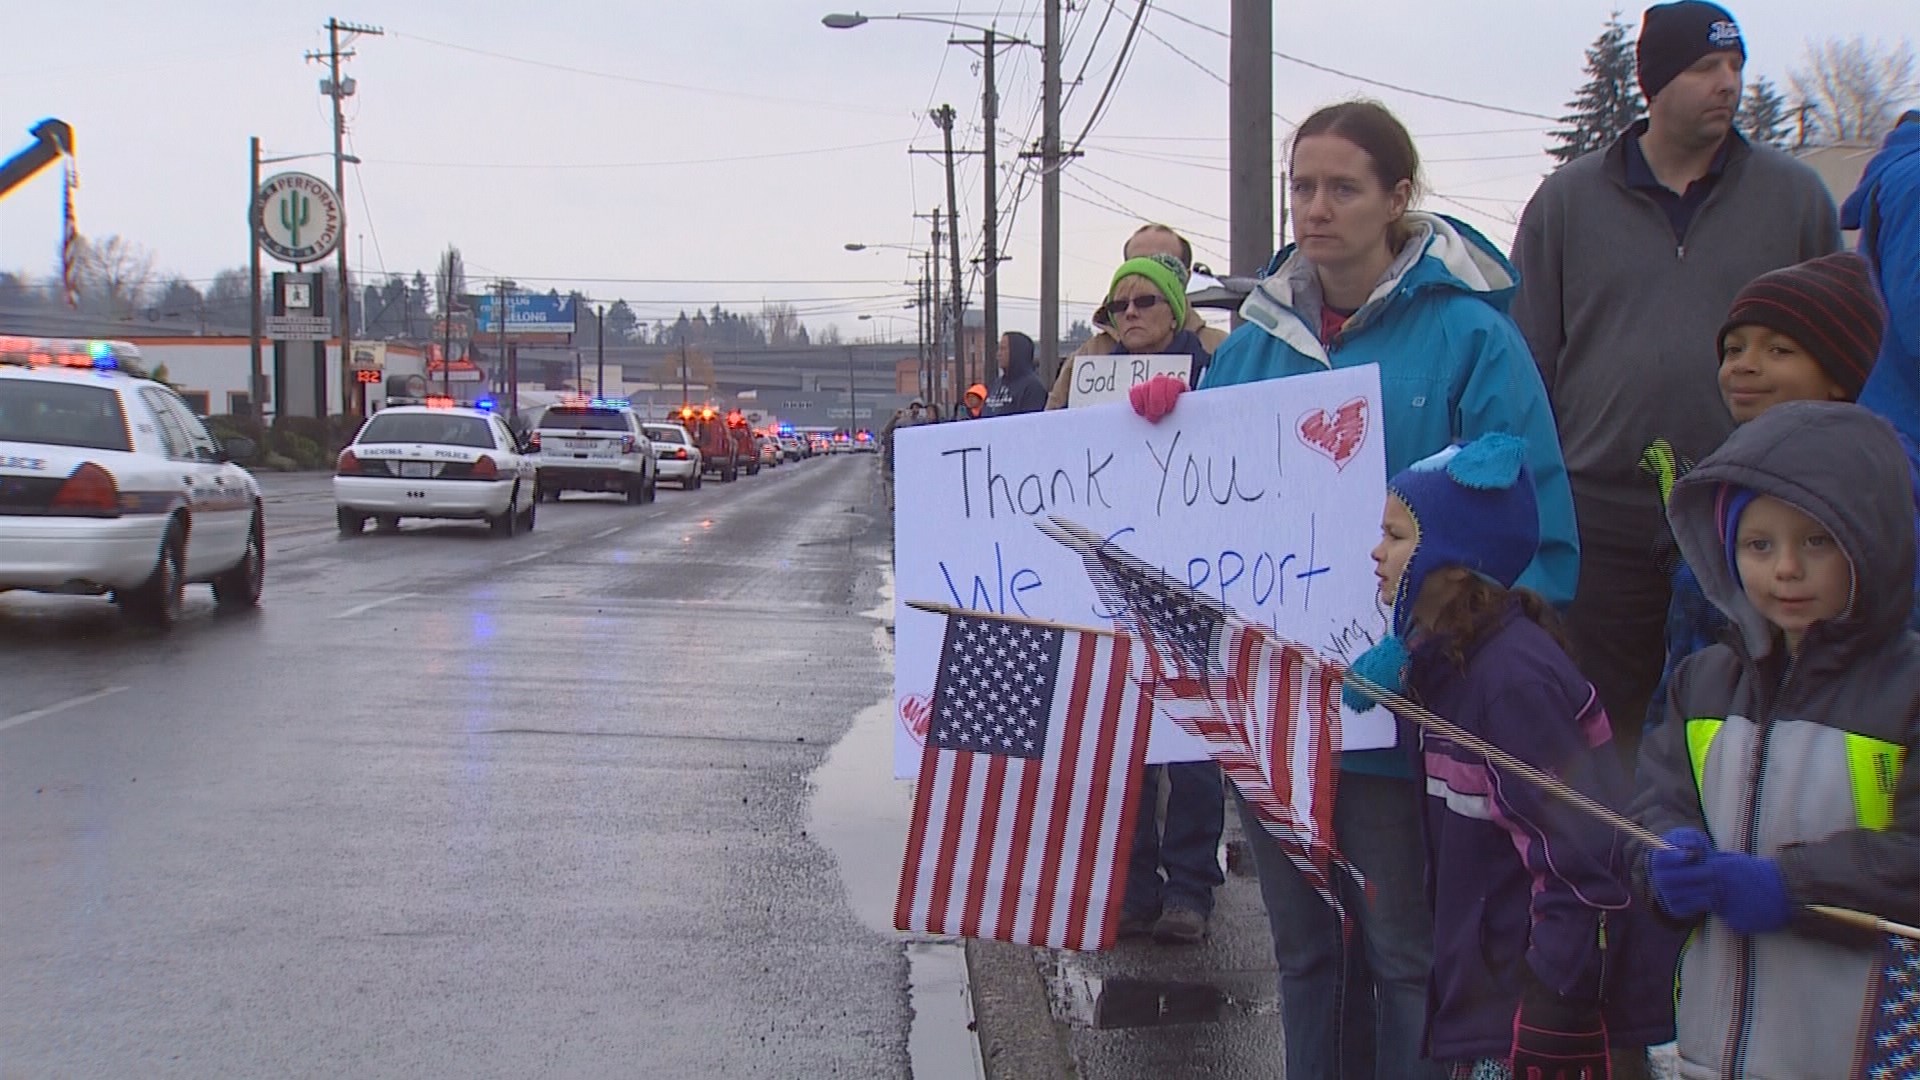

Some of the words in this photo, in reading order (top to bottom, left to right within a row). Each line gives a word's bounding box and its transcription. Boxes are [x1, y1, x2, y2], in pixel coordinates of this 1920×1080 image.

[277, 177, 337, 252] PERFORMANCE
[1076, 360, 1117, 394] God
[363, 448, 403, 456] TACOMA
[435, 450, 470, 460] POLICE
[941, 444, 1114, 519] Thank
[938, 541, 1043, 618] We
[1091, 512, 1332, 619] Spport
[1319, 617, 1376, 667] ying
